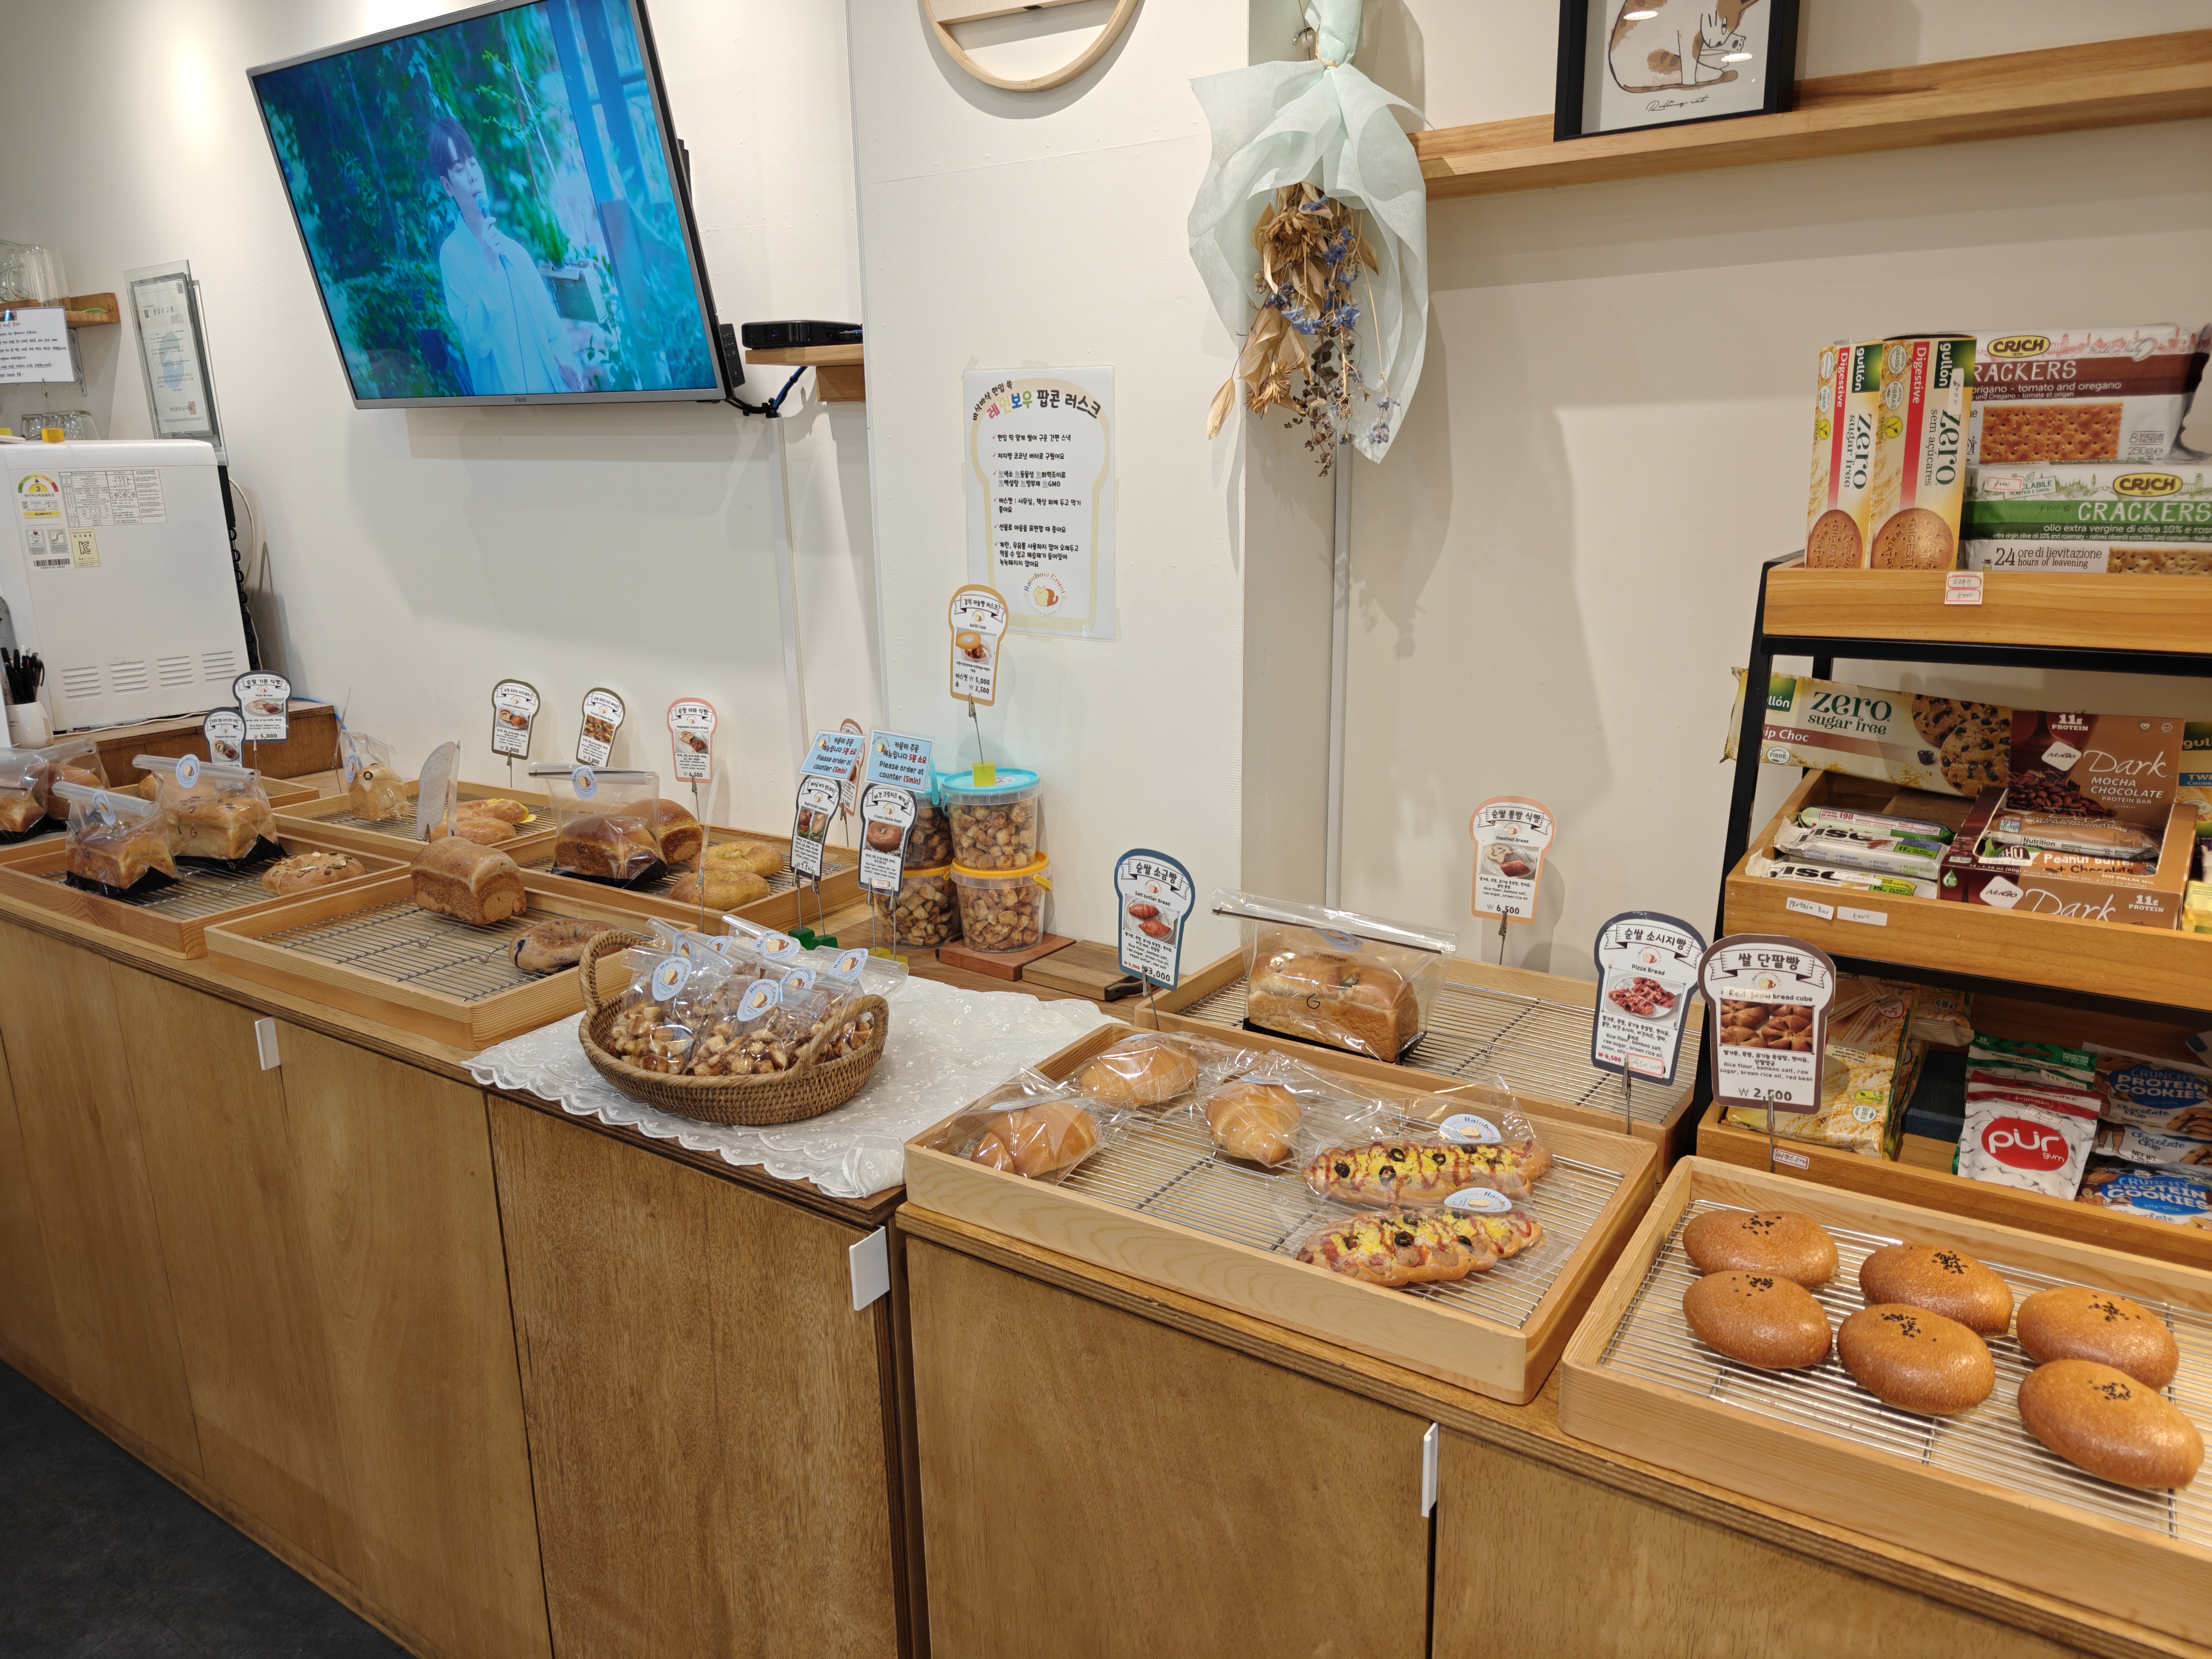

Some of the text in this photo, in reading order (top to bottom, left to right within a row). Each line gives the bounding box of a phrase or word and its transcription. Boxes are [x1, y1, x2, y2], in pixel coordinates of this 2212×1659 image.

[1993, 339, 2044, 353] CRICH
[1855, 348, 1865, 391] gullón
[1913, 347, 1927, 404] Digestive
[1973, 360, 2076, 382] RACKERS
[1837, 353, 1848, 408] Digestive
[2018, 381, 2121, 392] tomato and oregano
[992, 383, 1004, 396] 한입
[987, 389, 1101, 419] 레인보우 팝콘 러스크
[1929, 409, 1938, 434] sem
[1844, 415, 1856, 488] sugar free
[1853, 414, 1872, 489] zero
[2120, 478, 2175, 491] CRICH
[2078, 501, 2212, 523] CRACKERS
[2044, 524, 2160, 534] olio extra vergine di oliva
[1994, 547, 2102, 566] 24 ore di lievitazione
[2018, 558, 2039, 567] hours
[2052, 558, 2088, 569] leavening
[1024, 572, 1049, 591] Rainbow
[975, 677, 990, 686] 5,000
[975, 685, 989, 694] 2,500
[1810, 692, 1892, 722] zero
[1808, 714, 1887, 735] sugar free
[2059, 714, 2083, 725] 11g
[1779, 729, 1810, 742] Choc
[894, 741, 919, 753] 카운터 주문
[816, 754, 832, 763] Please
[832, 757, 846, 765] order
[883, 747, 908, 760] 메뉴입니다
[909, 754, 917, 763] 5분
[813, 764, 848, 774] counter (5min)
[879, 760, 924, 775] Please order at
[2083, 751, 2170, 778] Dark
[879, 771, 921, 785] counter (5min)
[2091, 777, 2136, 787] MOCHA
[2091, 786, 2164, 798] CHOCOLATE
[1492, 810, 1540, 824] 순쌀 식빵
[1839, 812, 1853, 820] 190
[2023, 837, 2055, 847] Nutrition
[2044, 853, 2090, 864] Peanut
[1136, 862, 1177, 884] 순쌀 소금빵
[2129, 904, 2164, 912] PROTEIN
[1625, 928, 1686, 950] 순쌀 소시지빵
[1313, 951, 1334, 959] DESSERT
[1738, 953, 1800, 970] 쌀 단팥빵
[660, 959, 686, 970] Rainbow
[1632, 964, 1665, 976] Pizza Bread
[750, 981, 773, 993] Rainbow
[1729, 989, 1746, 998] Red
[1632, 1040, 1650, 1048] bamboo
[2117, 1074, 2208, 1093] PROTEIN
[2115, 1084, 2209, 1100] COOKIES
[2015, 1096, 2049, 1105] cinnamon
[1861, 1107, 1869, 1120] FIBRE
[2042, 1152, 2064, 1163] gum
[2119, 1178, 2189, 1188] CRUNCHY
[2107, 1184, 2207, 1200] PROTEIN
[2108, 1189, 2209, 1210] COOKIES
